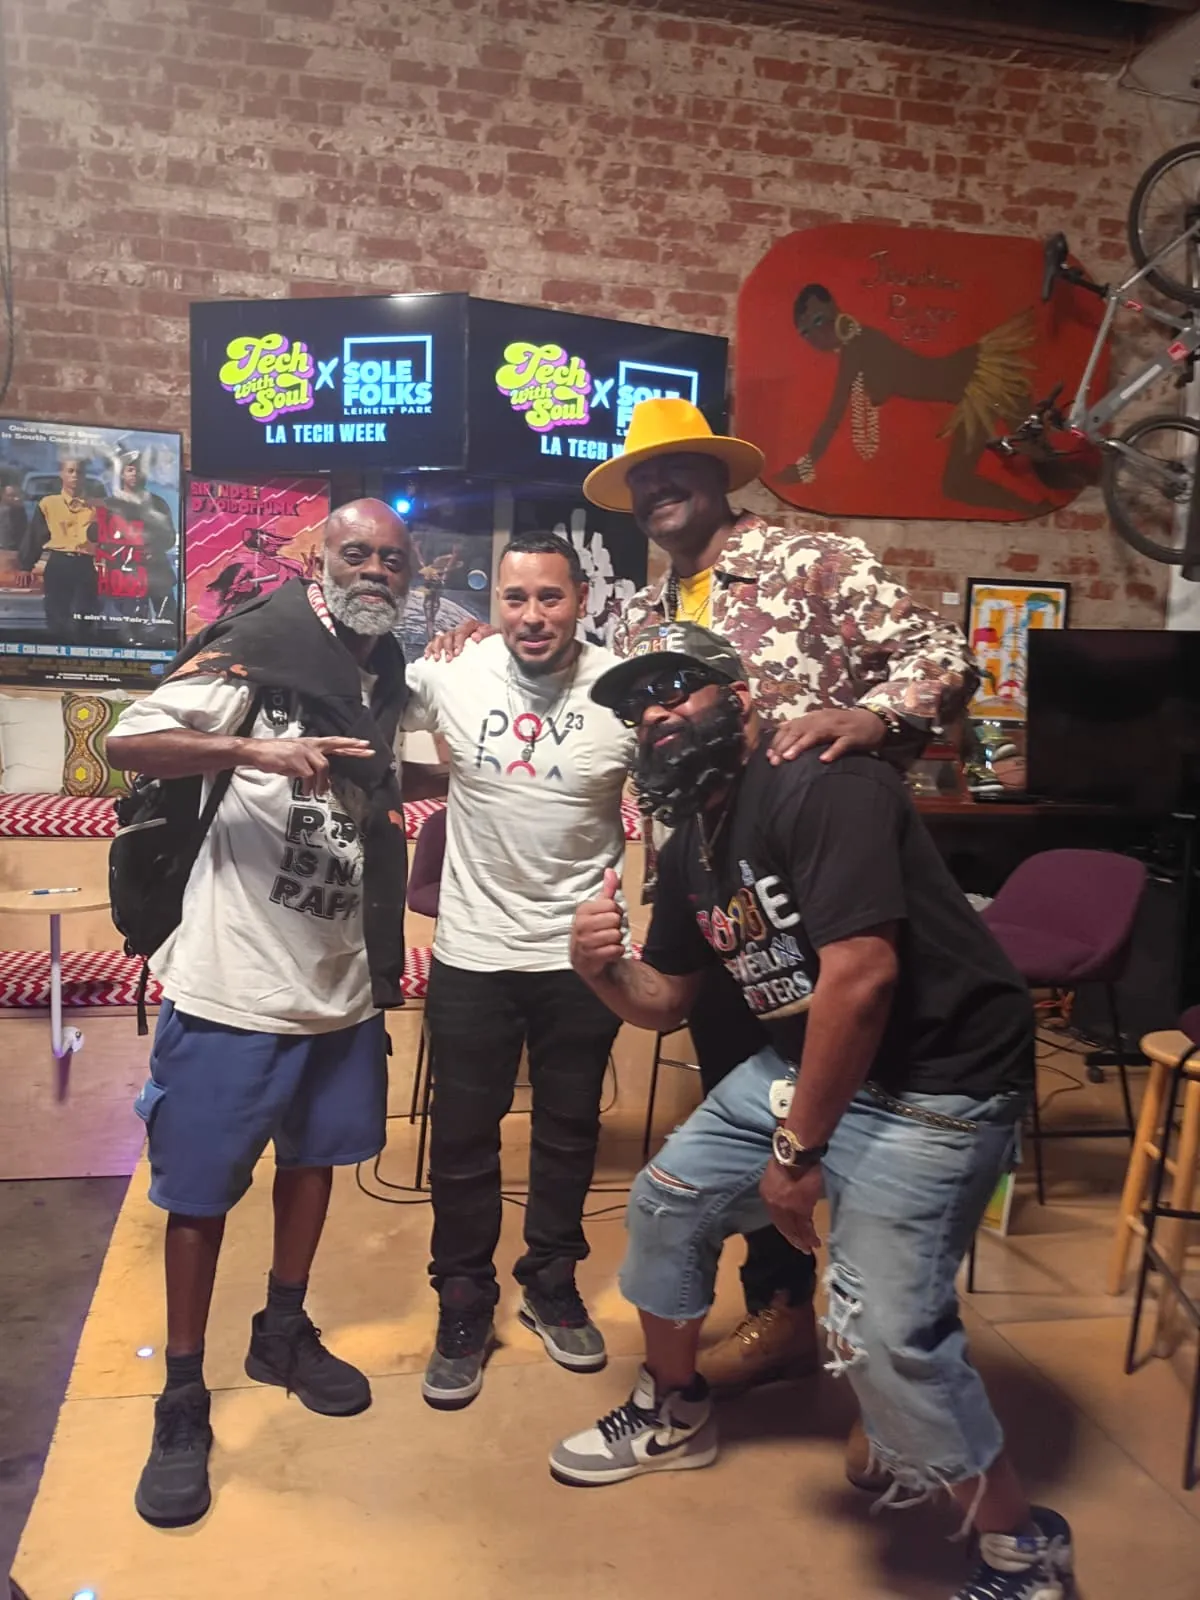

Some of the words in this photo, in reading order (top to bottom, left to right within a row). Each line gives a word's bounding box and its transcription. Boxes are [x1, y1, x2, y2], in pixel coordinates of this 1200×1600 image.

[219, 333, 310, 385] Tech
[495, 342, 587, 390] Tech
[343, 360, 413, 384] SOLE
[233, 374, 275, 399] with
[249, 373, 310, 418] Soul
[343, 382, 433, 406] FOLKS
[510, 384, 553, 405] with
[400, 406, 433, 414] PARK
[525, 386, 587, 427] Soul
[14, 432, 47, 441] South
[265, 424, 287, 444] LA
[294, 423, 335, 443] TECH
[339, 423, 387, 442] WEEK
[541, 434, 562, 456] LA
[568, 438, 608, 460] TECH
[564, 711, 585, 731] 23
[280, 847, 319, 877] IS
